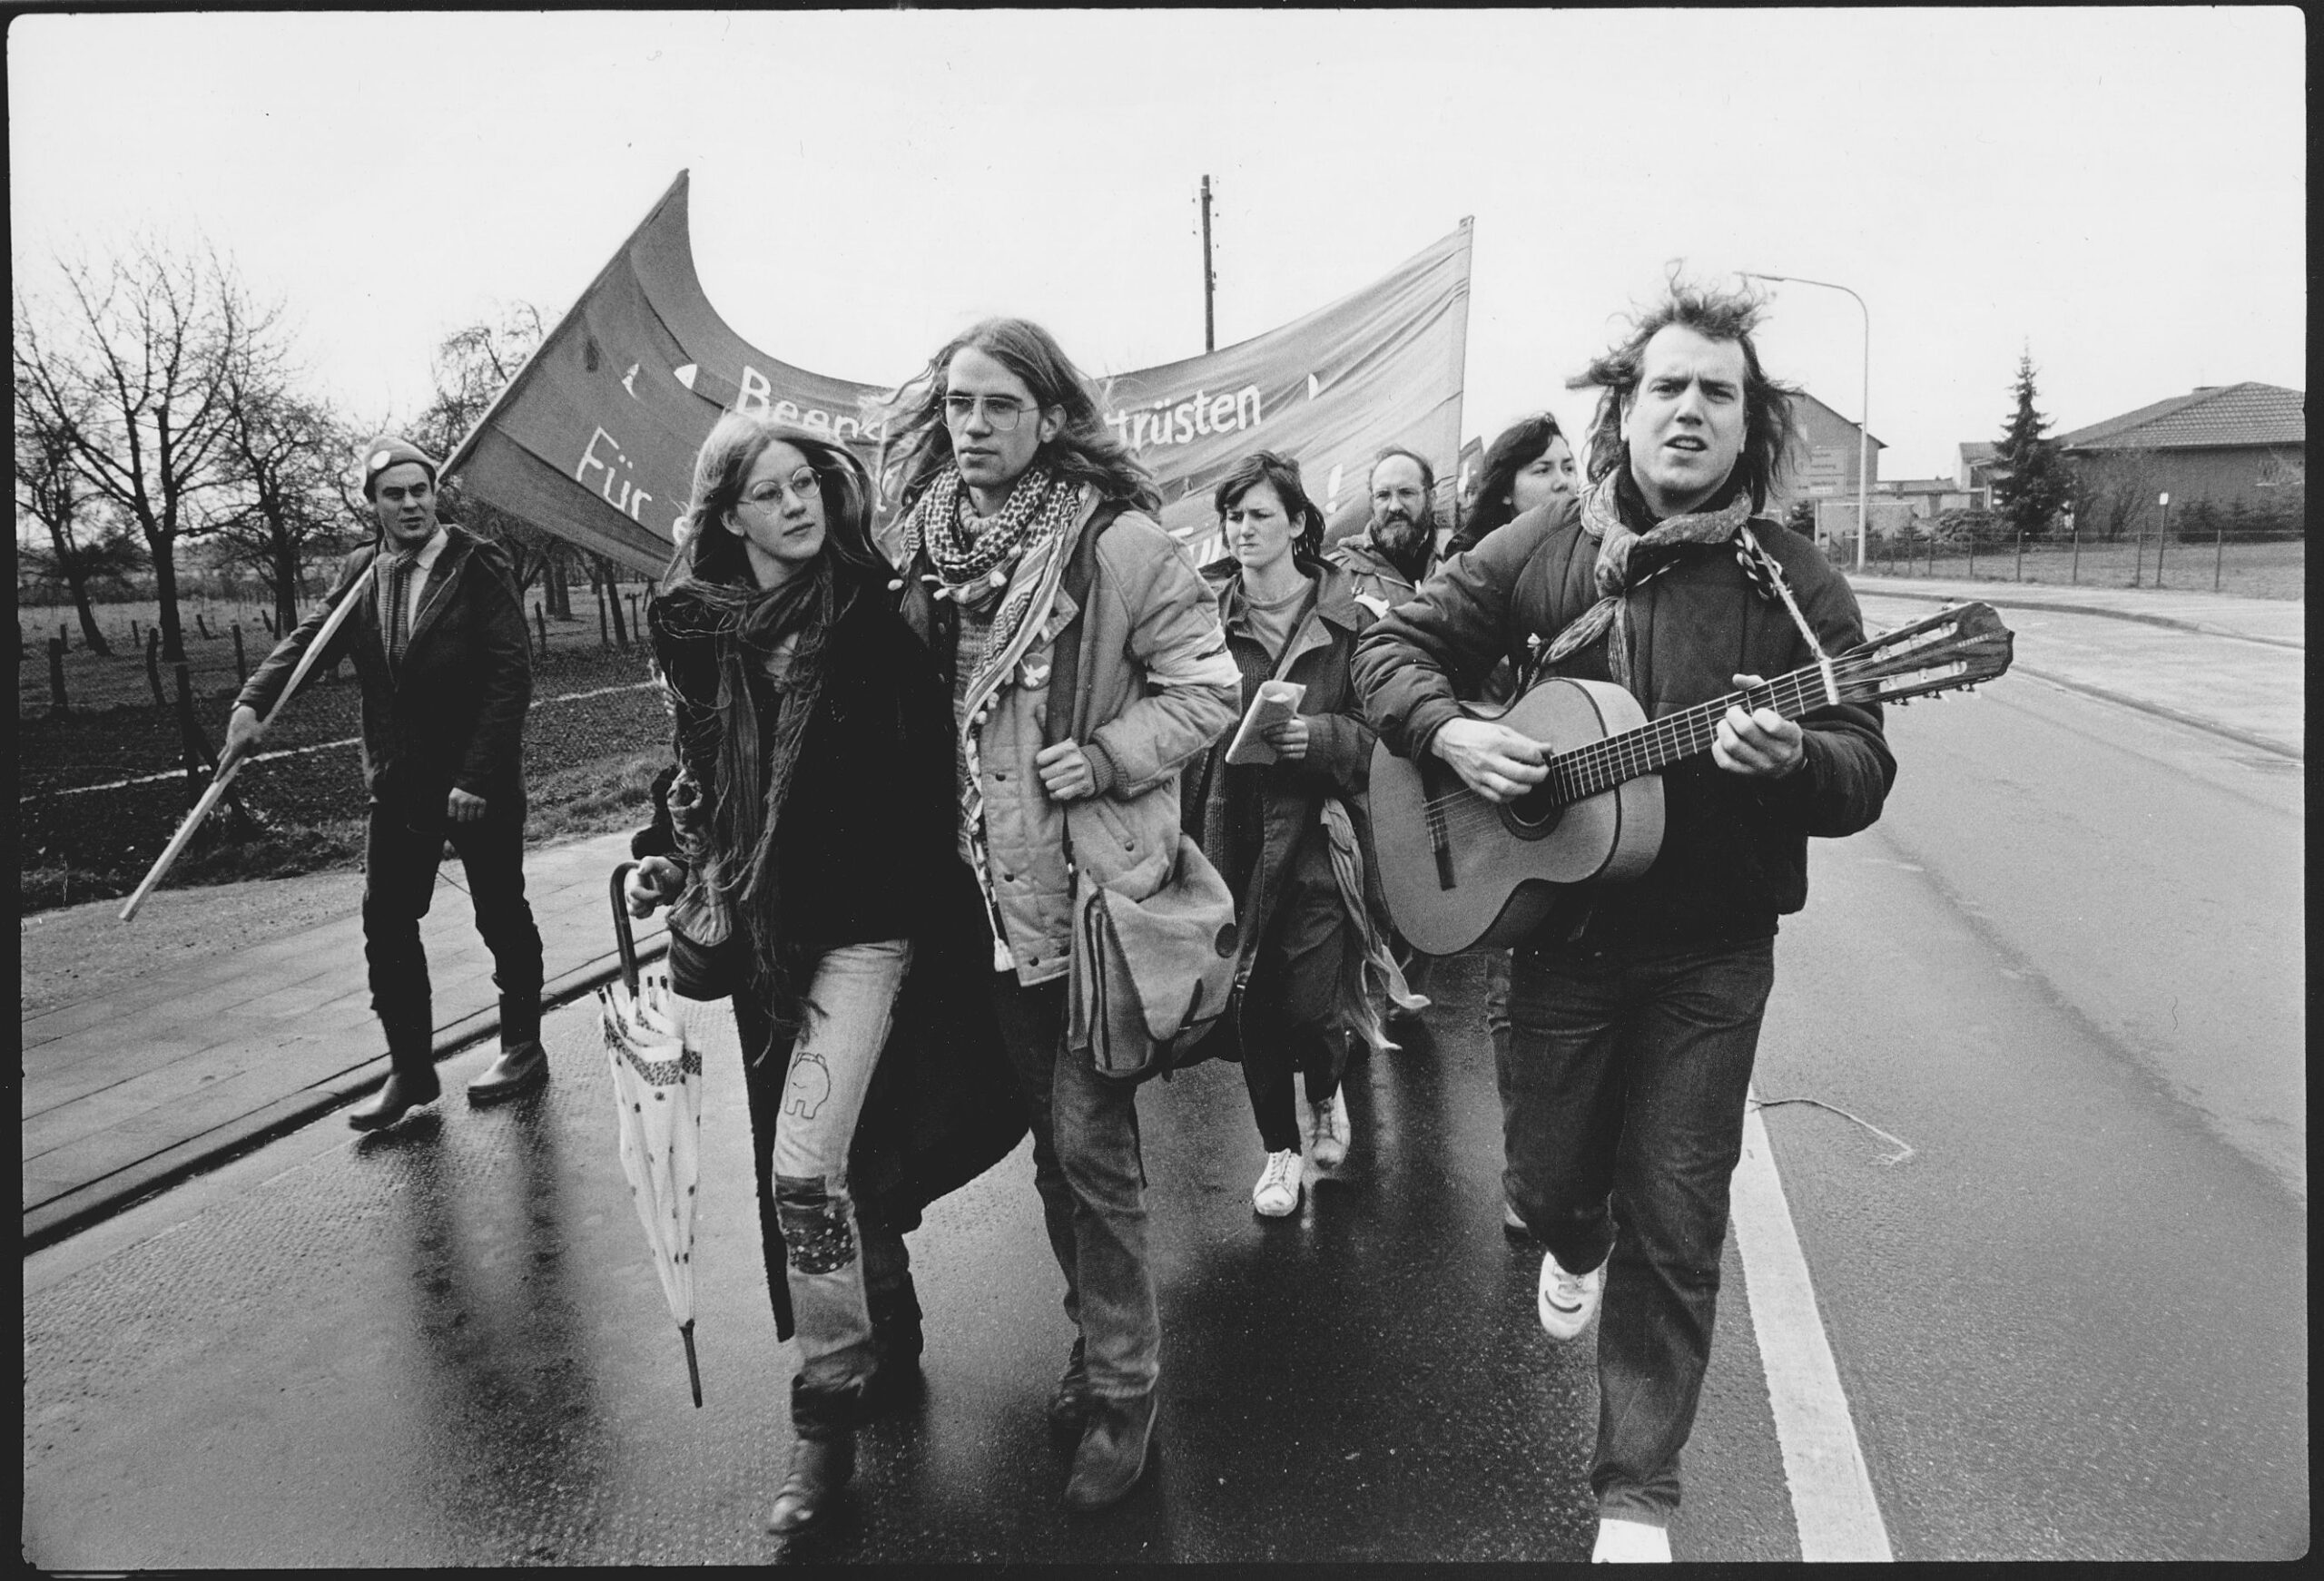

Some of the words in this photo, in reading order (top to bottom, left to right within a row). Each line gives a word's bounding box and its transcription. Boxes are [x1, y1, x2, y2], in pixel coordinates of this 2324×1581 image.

[736, 365, 887, 443] Beend
[1103, 384, 1261, 452] trüsten
[576, 426, 653, 522] Für
